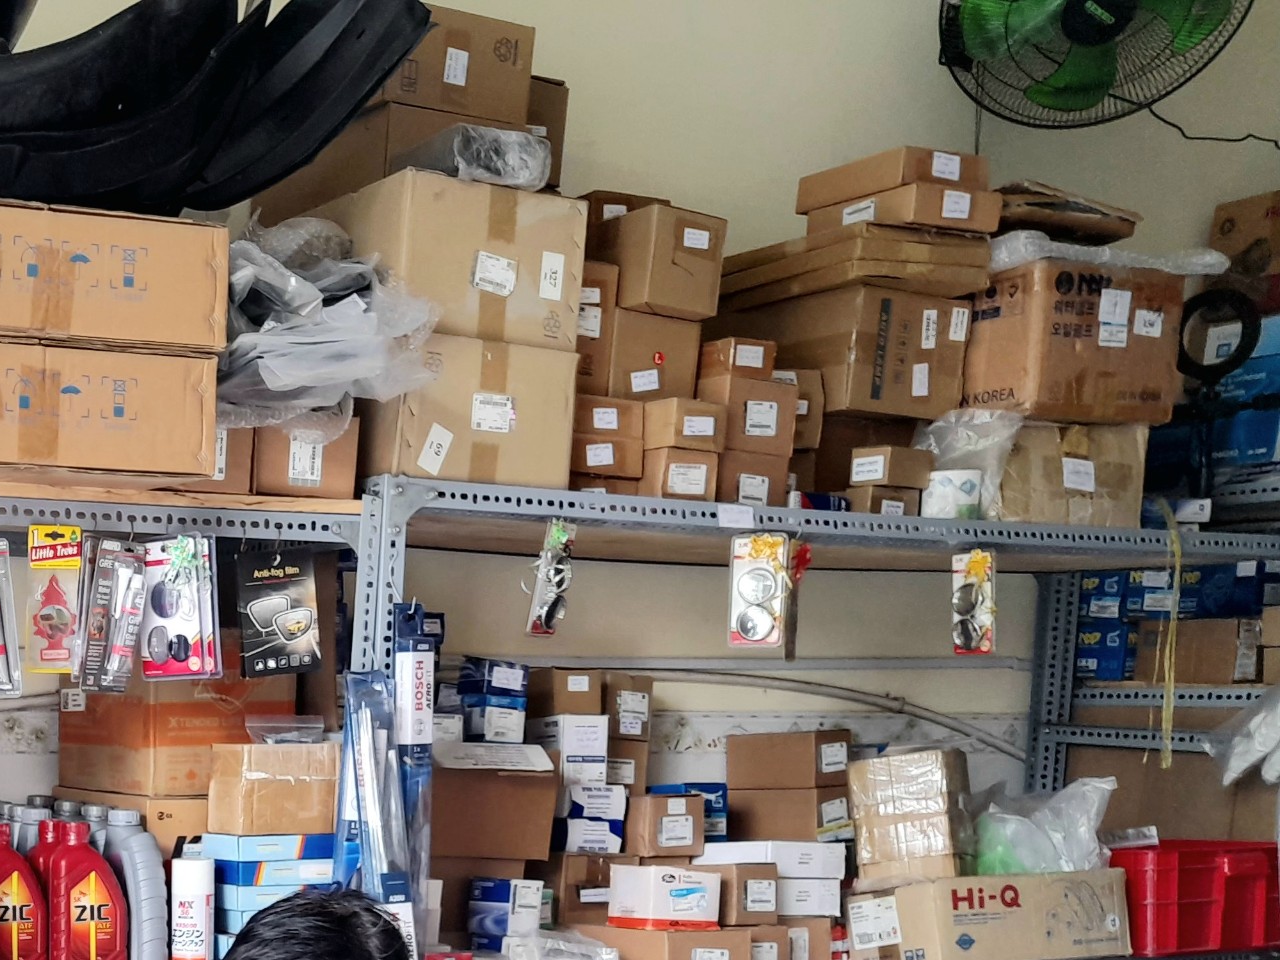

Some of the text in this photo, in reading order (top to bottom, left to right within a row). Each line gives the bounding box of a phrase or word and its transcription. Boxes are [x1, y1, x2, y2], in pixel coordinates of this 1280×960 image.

[973, 387, 1015, 404] KOREA
[32, 529, 39, 547] 1
[102, 540, 121, 551] ABRO
[31, 545, 78, 561] Little Trees
[253, 565, 300, 579] Anti-fog film
[415, 660, 424, 711] BOSCH
[951, 884, 1022, 911] Hi-Q
[74, 903, 112, 922] ZIC
